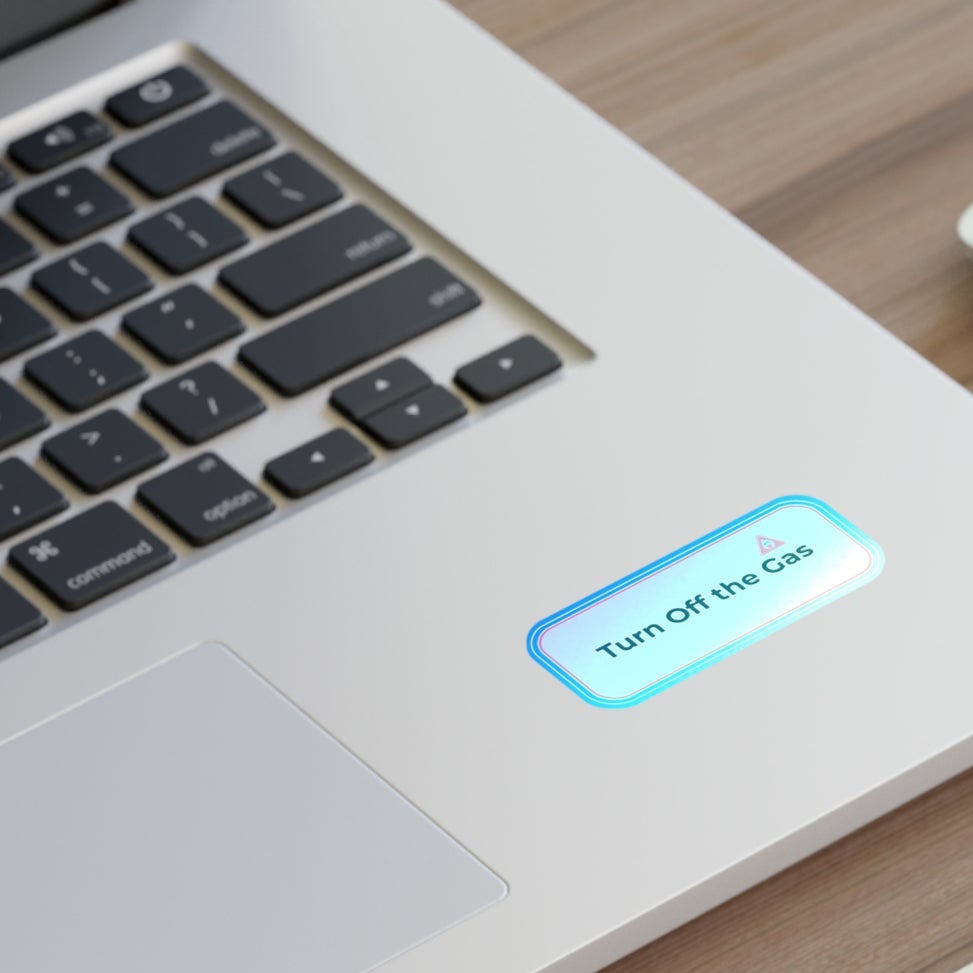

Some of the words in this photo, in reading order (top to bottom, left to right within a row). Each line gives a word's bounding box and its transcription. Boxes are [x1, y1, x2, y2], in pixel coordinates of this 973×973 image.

[203, 489, 260, 522] option
[66, 539, 154, 590] command
[595, 619, 665, 658] Turn
[665, 593, 710, 624] Off
[710, 573, 760, 601] the
[761, 542, 814, 574] Gas
